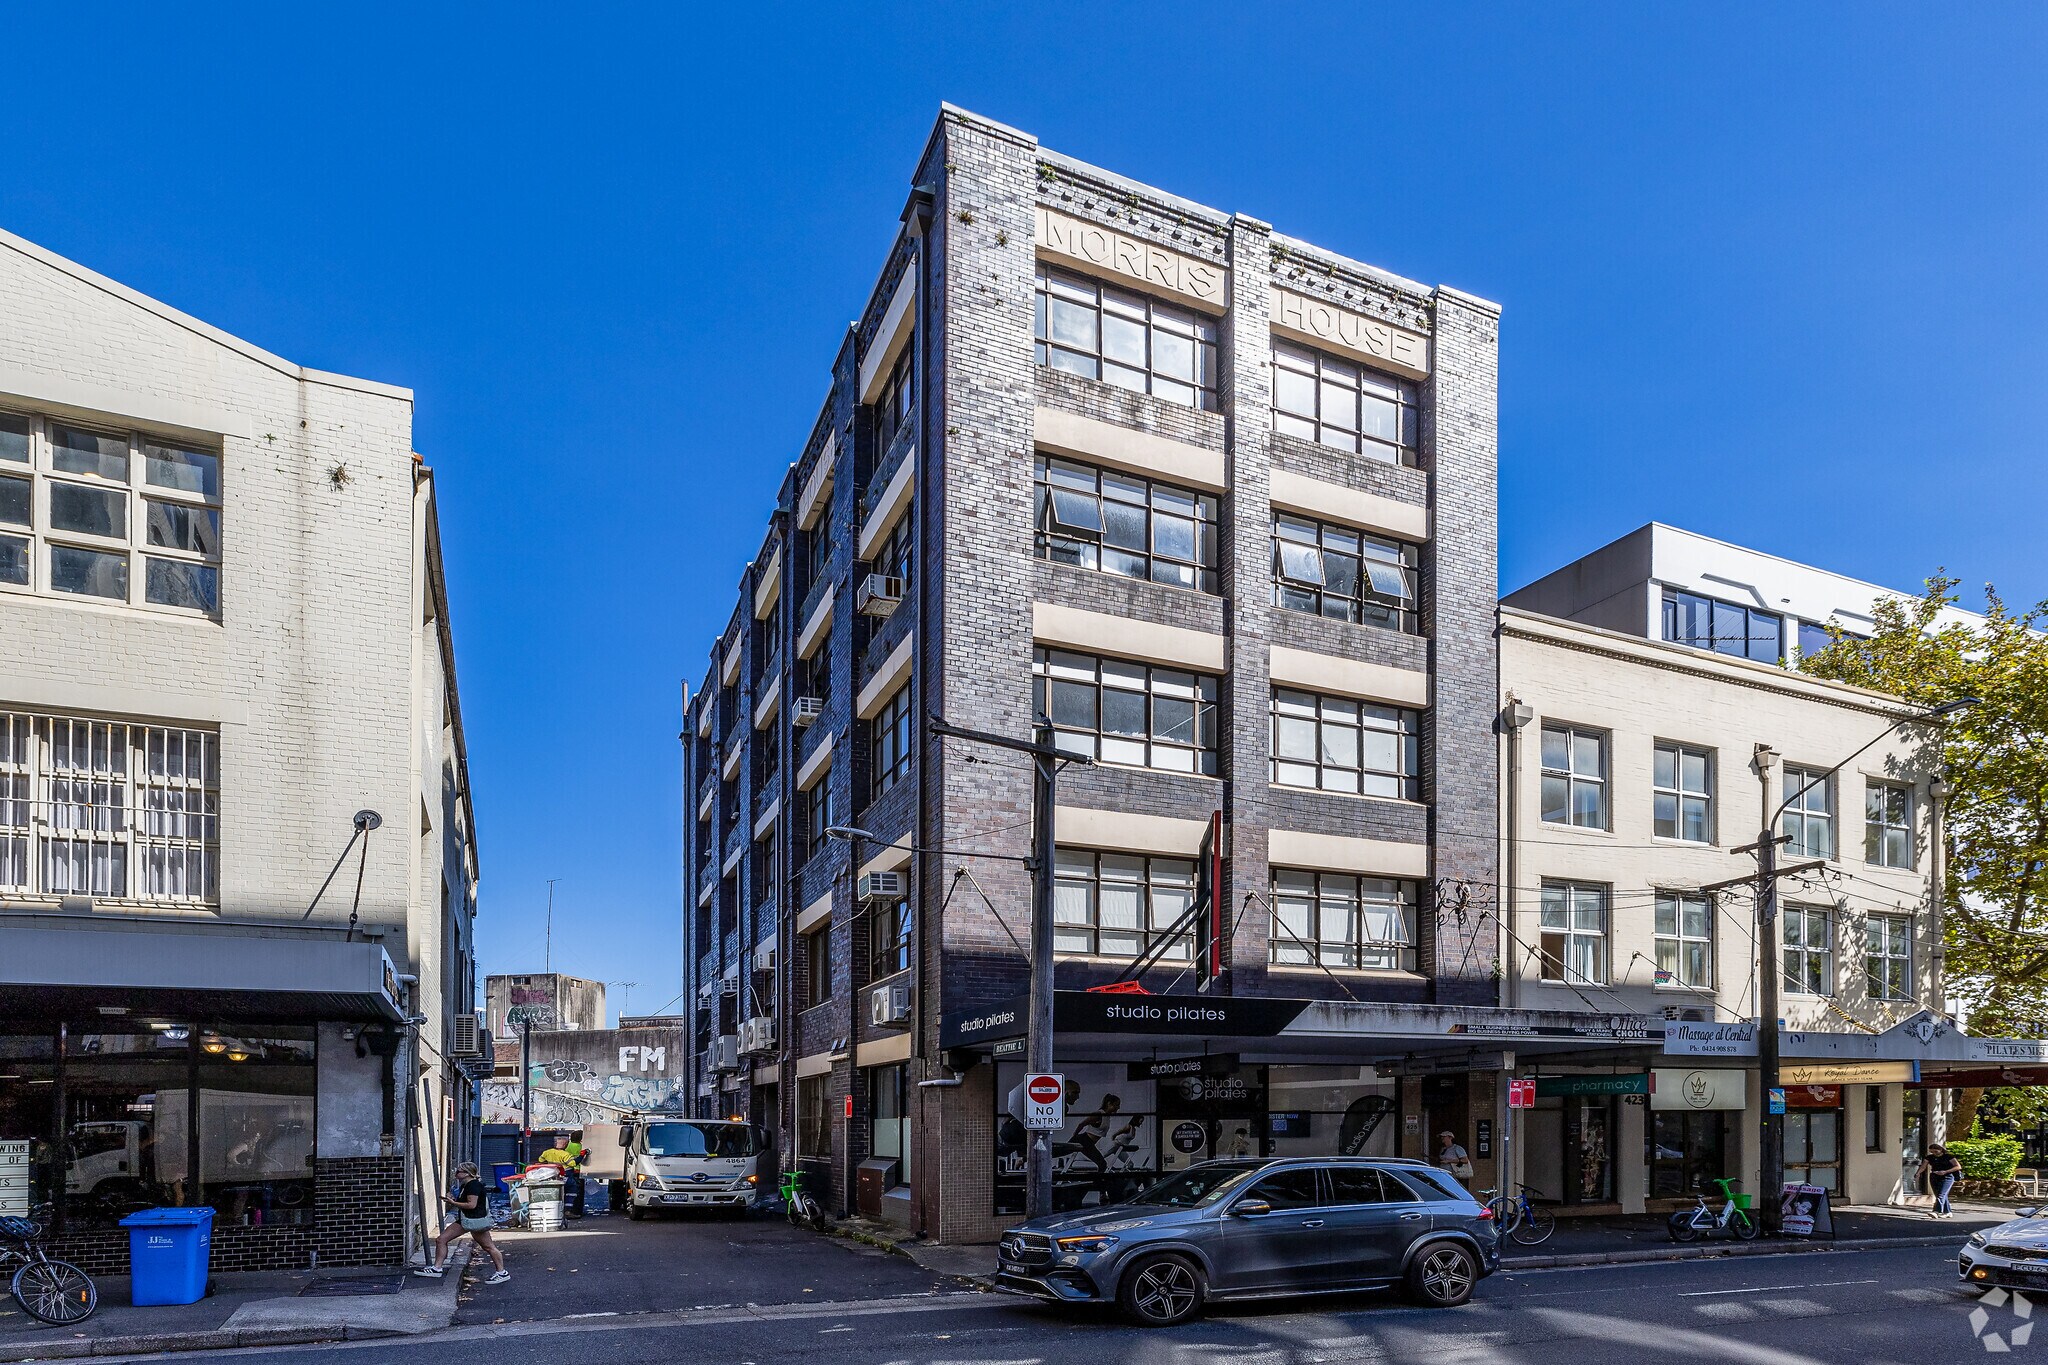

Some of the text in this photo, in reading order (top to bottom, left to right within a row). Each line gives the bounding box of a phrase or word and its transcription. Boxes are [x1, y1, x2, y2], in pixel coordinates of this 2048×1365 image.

[1046, 211, 1217, 298] MORRIS
[1280, 291, 1416, 367] HOUSE
[1106, 1004, 1226, 1022] studio pilates
[961, 1011, 1015, 1032] studio pilates
[1610, 1016, 1648, 1030] Office
[1678, 1025, 1754, 1044] Massage at Central
[1922, 1025, 1929, 1037] F
[996, 1042, 1016, 1053] BEATTIE
[1987, 1045, 2025, 1055] PILATES
[619, 1046, 666, 1072] FM
[1150, 1061, 1201, 1075] studio pilates
[1824, 1065, 1880, 1080] Royal Dance
[1204, 1077, 1244, 1088] studio
[1572, 1080, 1640, 1093] pharmacy
[1204, 1087, 1247, 1099] pilates
[1624, 1095, 1644, 1105] 423
[1036, 1106, 1054, 1115] NO
[1029, 1117, 1060, 1125] ENTRY
[1346, 1105, 1386, 1154] studio pilats
[8, 1156, 21, 1164] OF
[1786, 1185, 1822, 1193] Massage
